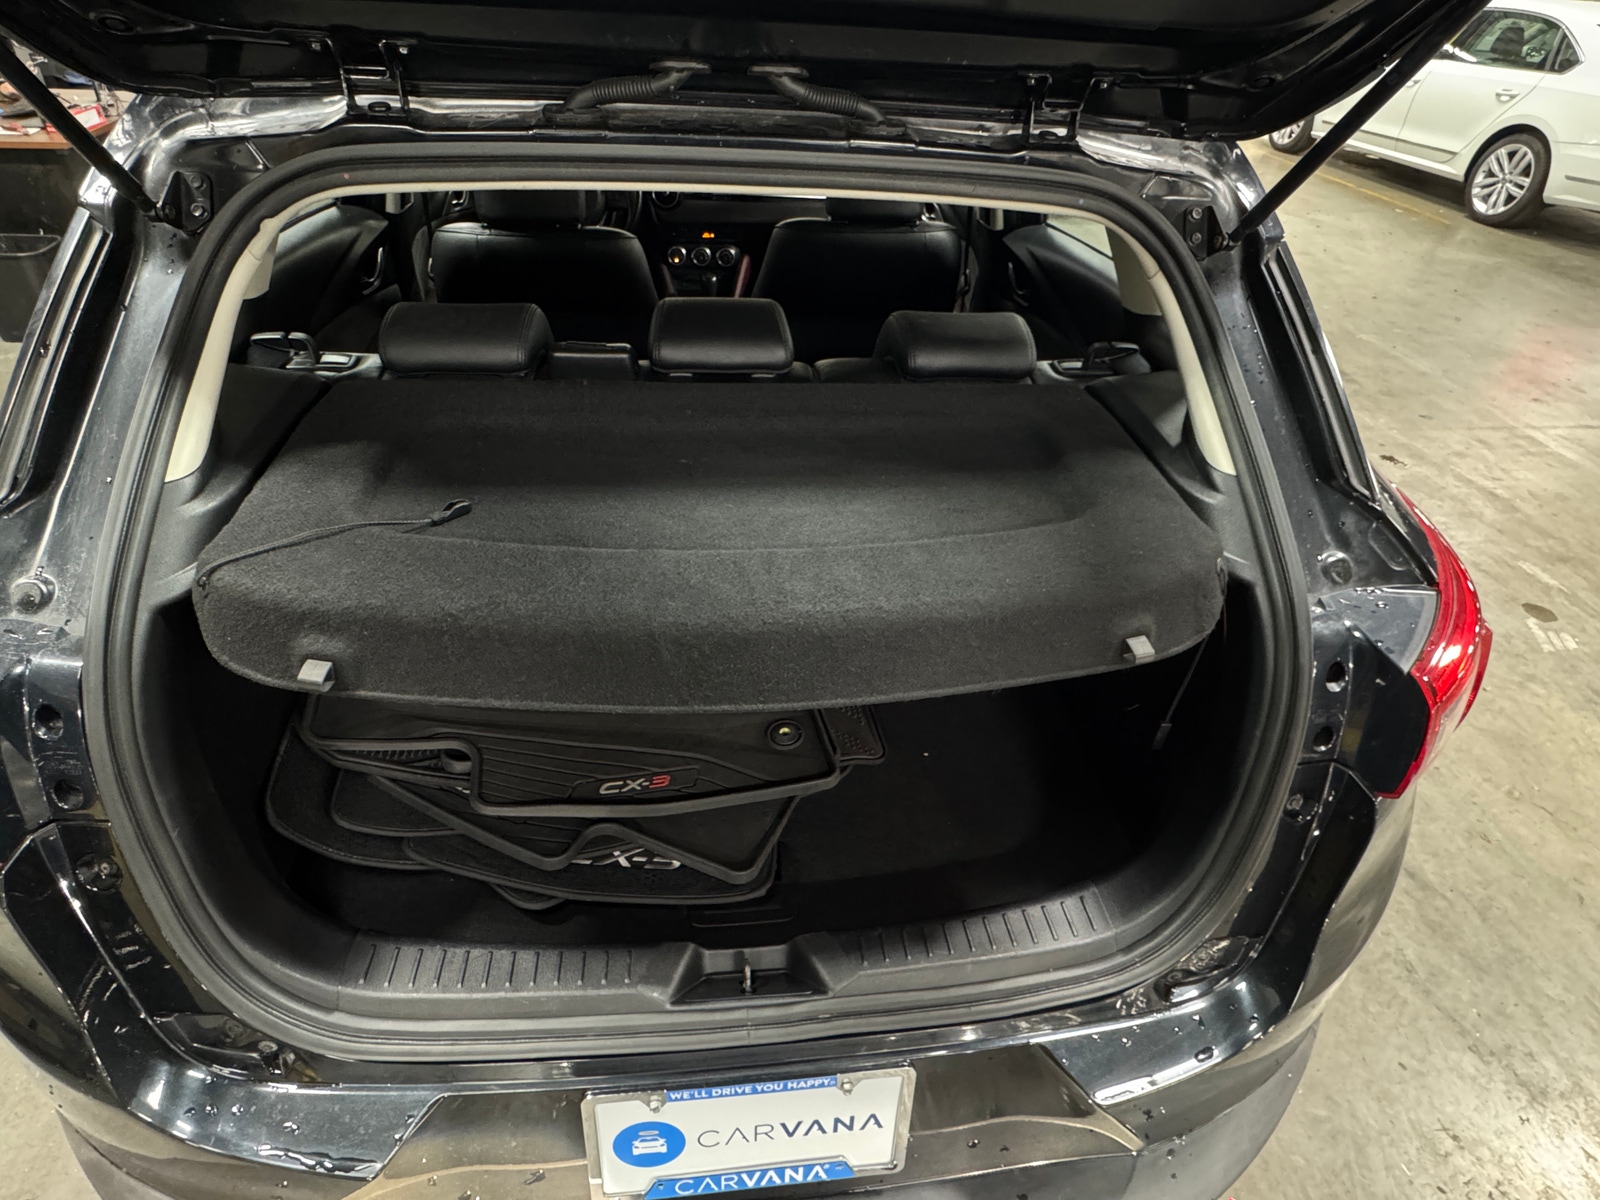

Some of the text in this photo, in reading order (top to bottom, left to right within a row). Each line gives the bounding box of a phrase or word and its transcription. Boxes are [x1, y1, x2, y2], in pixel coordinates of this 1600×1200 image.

[599, 774, 671, 795] CX-3
[669, 1089, 709, 1101] WE'LL
[711, 1085, 753, 1097] DRIVE
[755, 1083, 784, 1093] YOU
[697, 1113, 884, 1148] CARVANA
[674, 1164, 829, 1195] CARVANA
